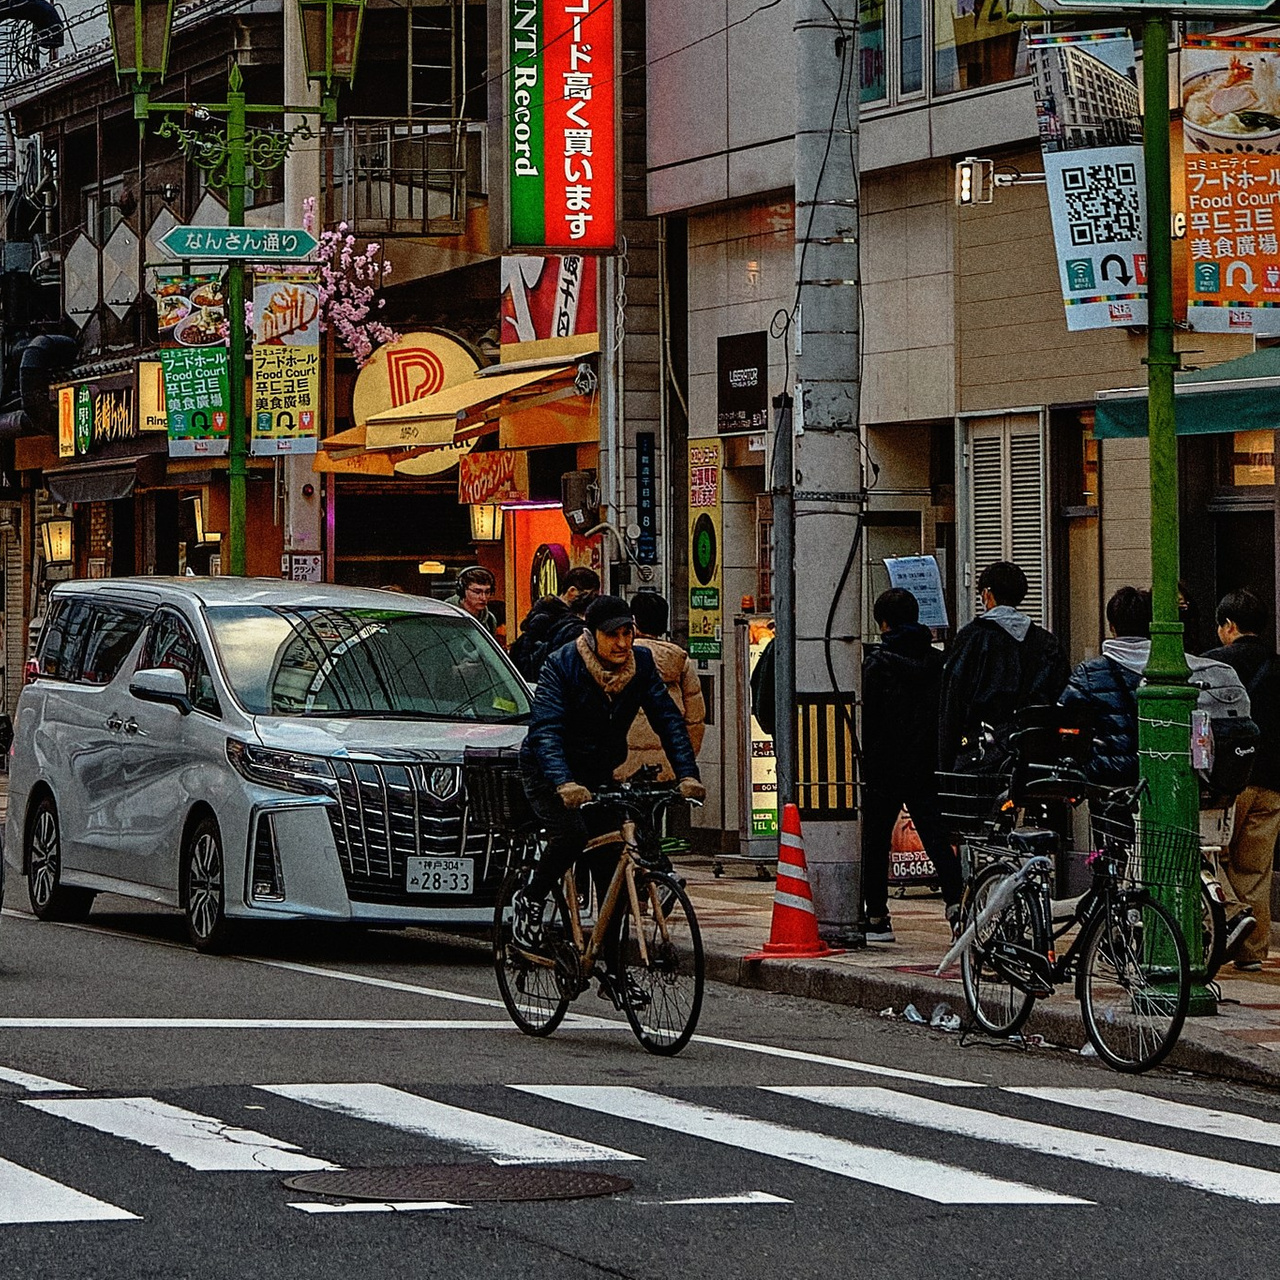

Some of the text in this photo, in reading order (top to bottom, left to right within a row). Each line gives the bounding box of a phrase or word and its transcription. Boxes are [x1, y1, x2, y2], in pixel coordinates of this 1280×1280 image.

[514, 64, 539, 177] Record
[1187, 158, 1260, 171] コミュニティー
[1188, 169, 1280, 192] フードホール
[1189, 193, 1232, 209] Food
[1191, 208, 1275, 235] 푸드코트
[184, 231, 298, 254] なんさん通り
[1190, 233, 1278, 261] 美食廣場
[165, 353, 227, 371] フードホール
[255, 354, 318, 369] フードホール
[165, 367, 226, 383] Food Court
[256, 366, 316, 381] Food Court
[167, 378, 220, 397] 푸드코트
[256, 378, 309, 396] 푸드코트
[421, 872, 469, 890] 28-33
